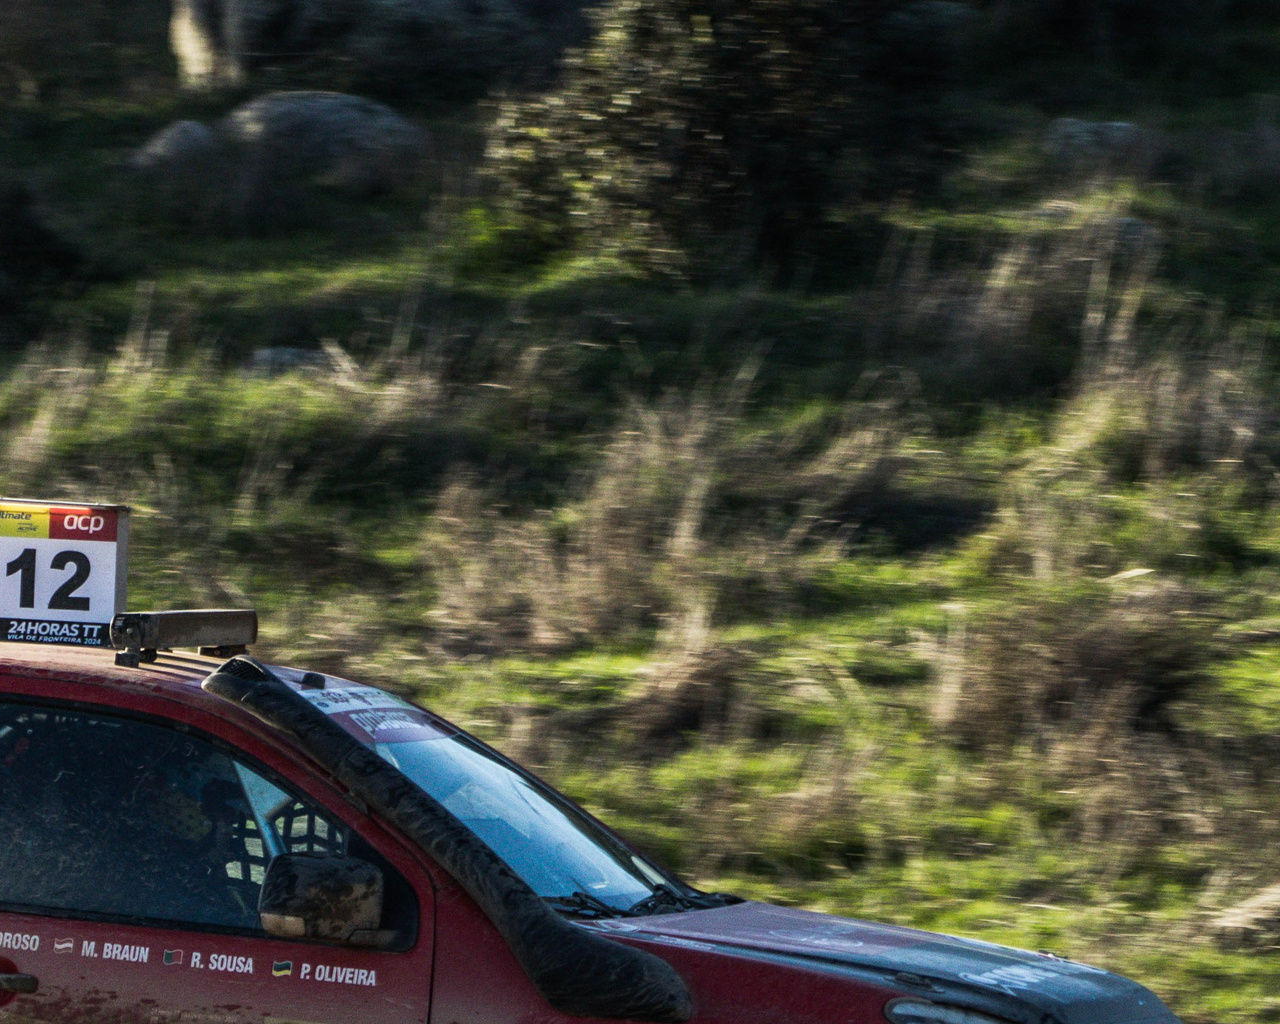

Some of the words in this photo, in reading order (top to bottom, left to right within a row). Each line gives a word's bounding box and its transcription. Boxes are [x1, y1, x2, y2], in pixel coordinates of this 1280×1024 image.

[63, 514, 105, 534] acp
[6, 548, 91, 611] 12
[39, 635, 82, 643] FRONTEIRA
[82, 624, 102, 638] TT
[81, 940, 98, 958] M.
[102, 942, 150, 963] BRAUN
[190, 951, 204, 969] R.
[208, 953, 254, 975] SOUSA
[299, 963, 311, 980] P.
[314, 964, 376, 987] OLIVEIRA
